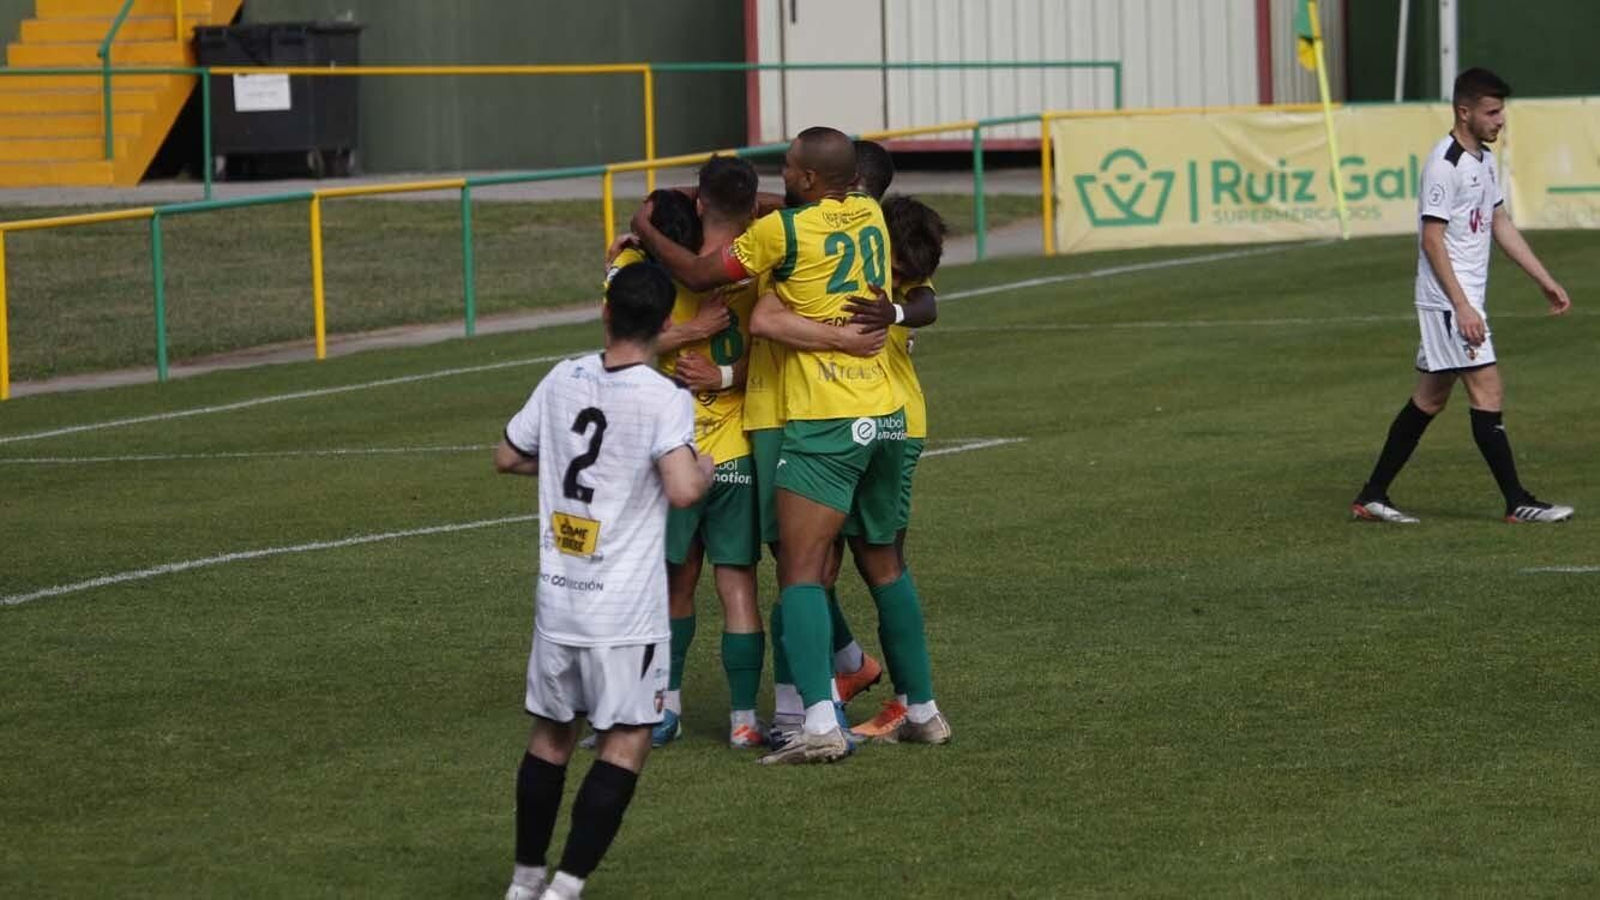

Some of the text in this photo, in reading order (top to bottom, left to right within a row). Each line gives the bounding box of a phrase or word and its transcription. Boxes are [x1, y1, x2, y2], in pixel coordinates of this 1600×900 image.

[1210, 153, 1420, 205] Ruiz Gal
[824, 225, 886, 295] 20
[563, 406, 608, 505] 2
